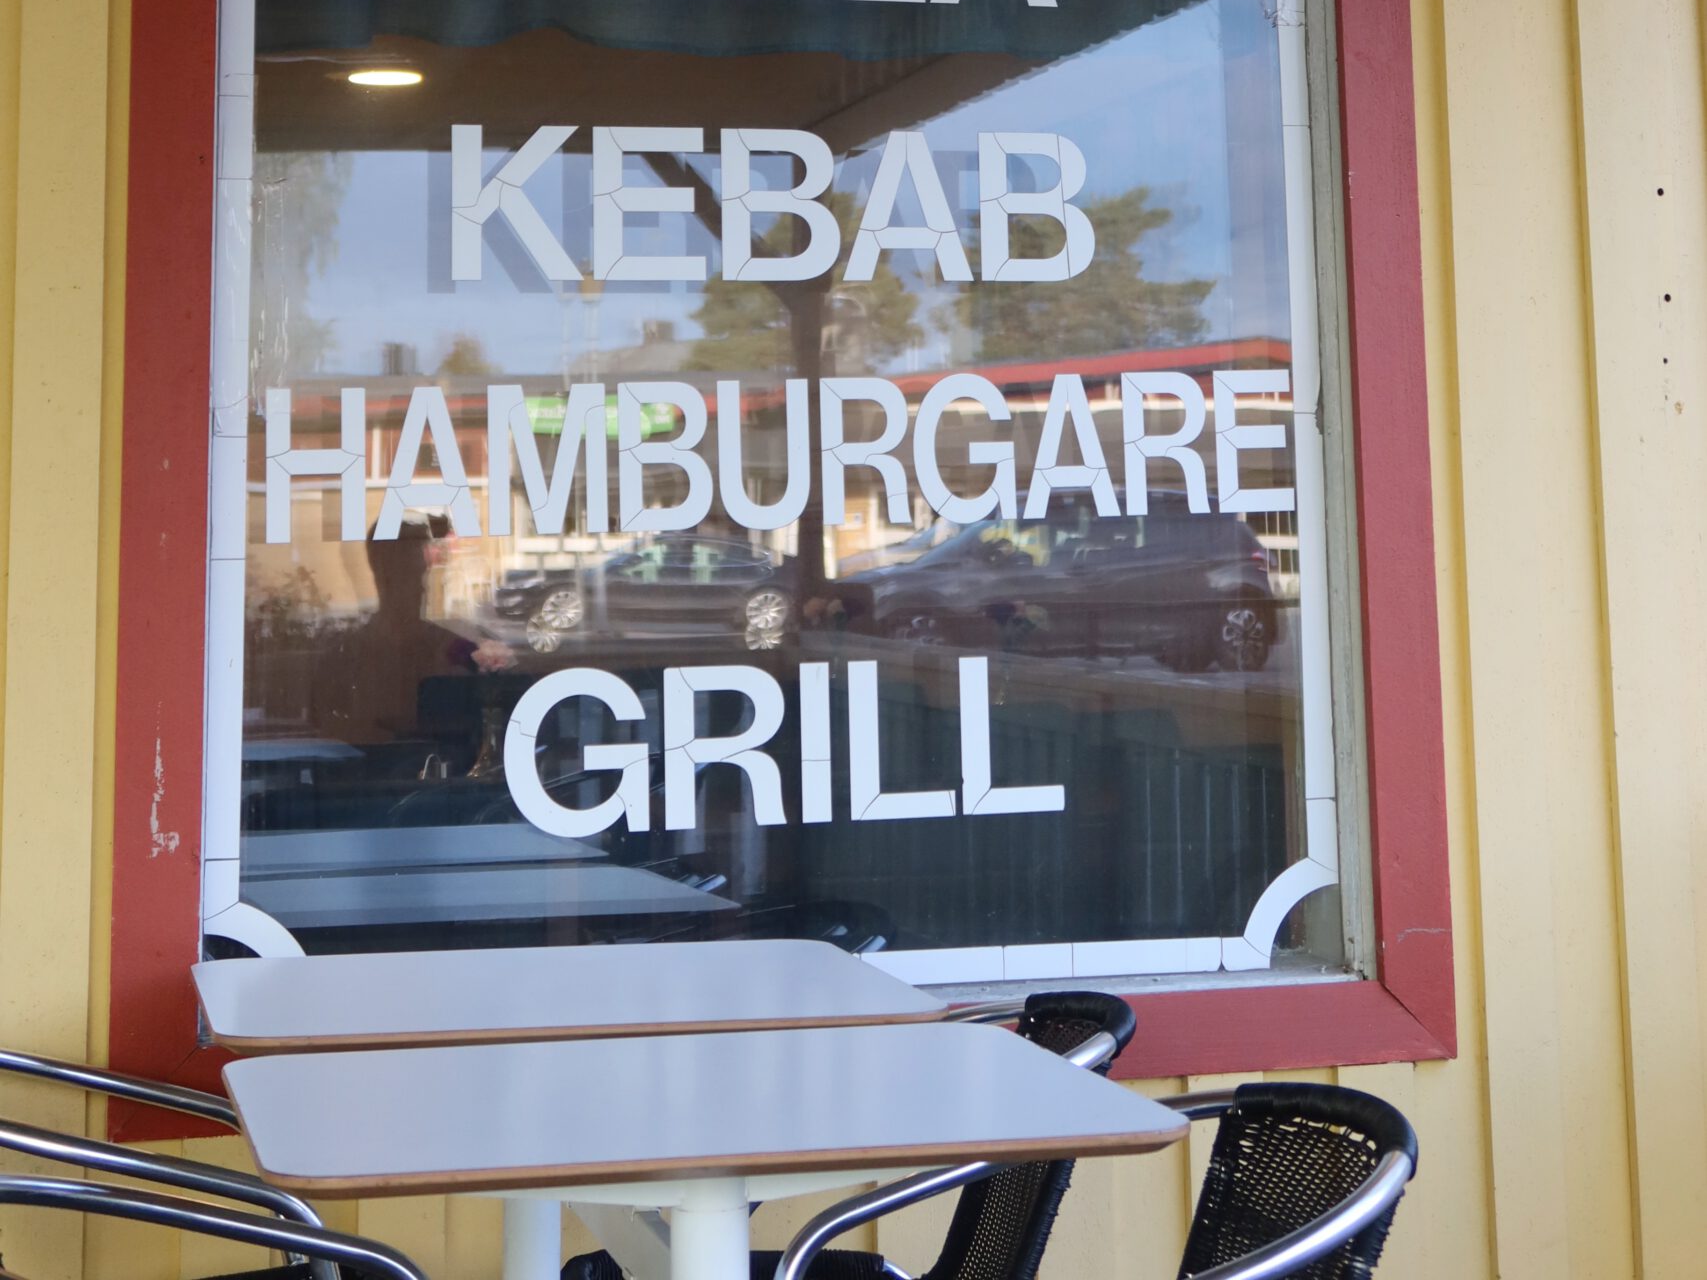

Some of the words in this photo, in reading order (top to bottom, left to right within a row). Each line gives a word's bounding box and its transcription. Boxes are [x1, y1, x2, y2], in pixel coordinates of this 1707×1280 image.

[451, 124, 1096, 283] KEBAB
[264, 369, 1296, 544] HAMBURGARE
[503, 656, 1067, 839] GRILL
